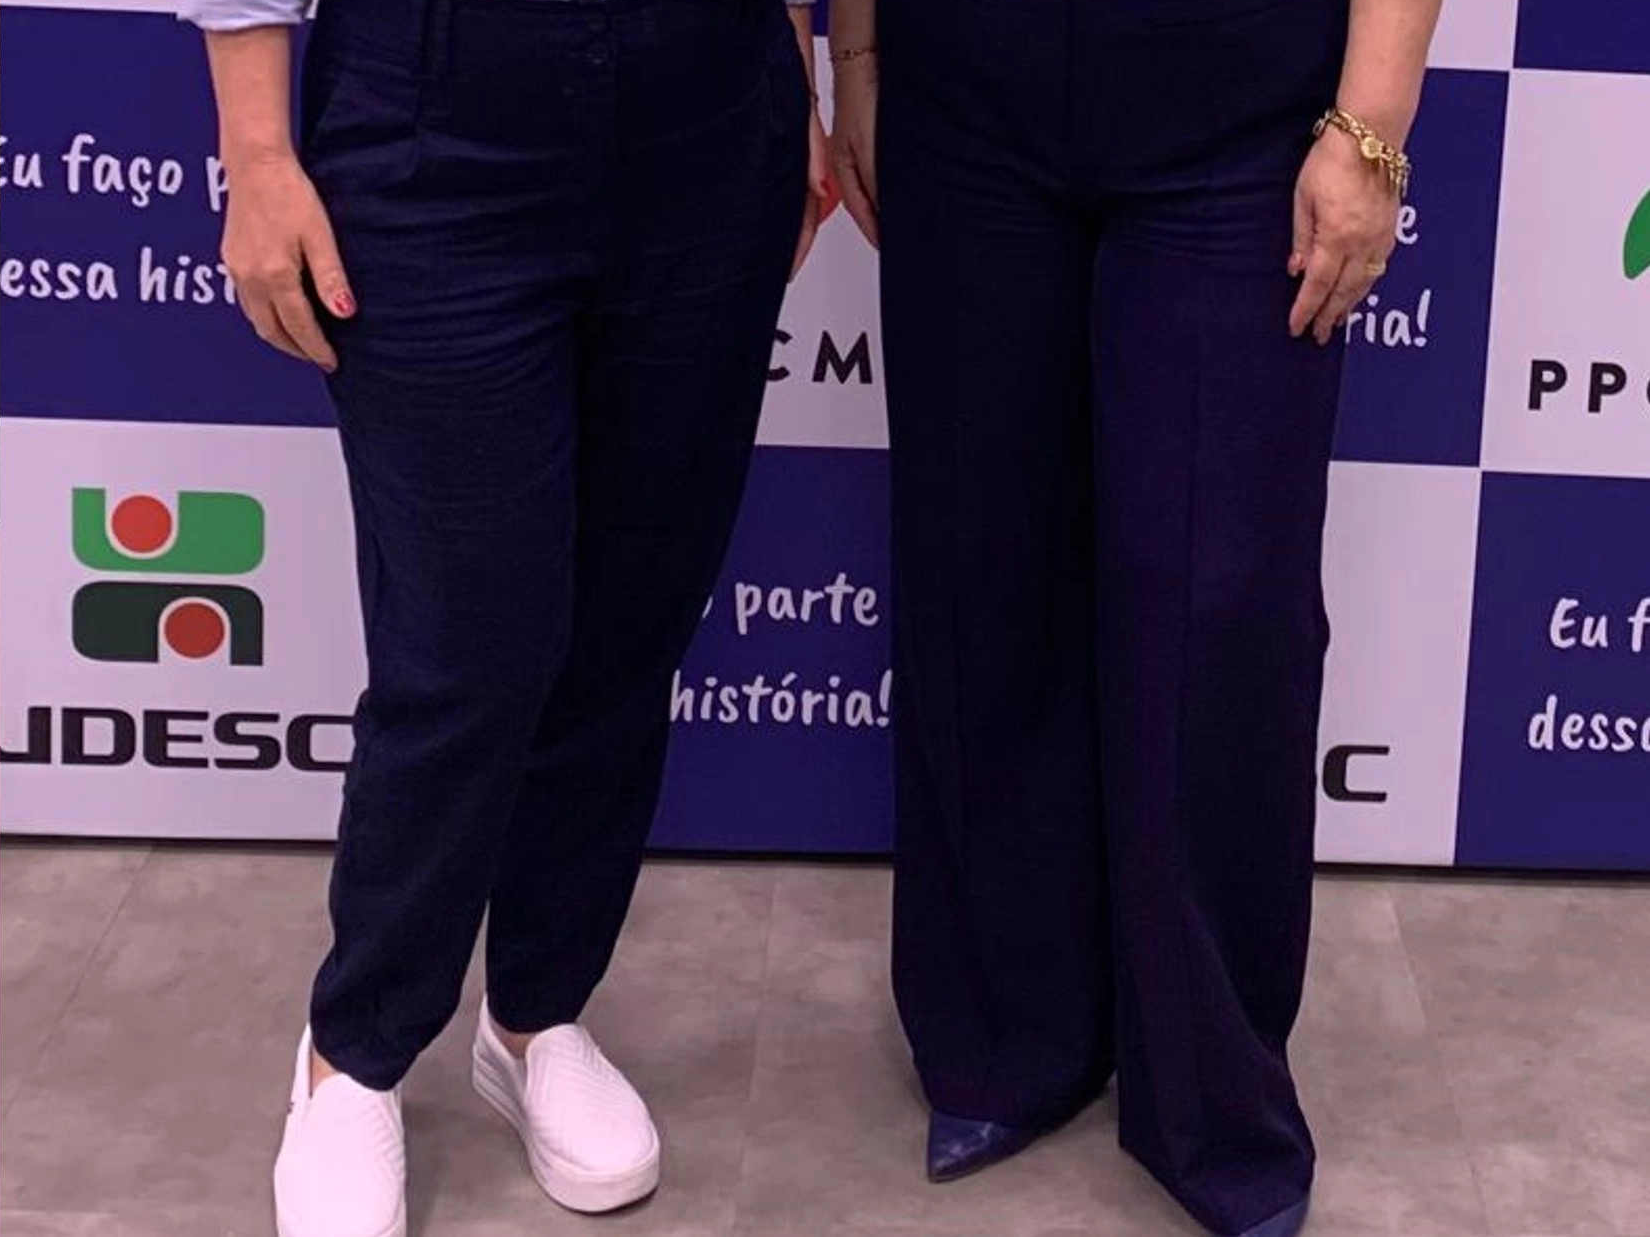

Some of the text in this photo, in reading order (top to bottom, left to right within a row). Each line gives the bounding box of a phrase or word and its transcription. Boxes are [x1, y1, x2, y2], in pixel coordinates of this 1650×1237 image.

[62, 134, 183, 208] faço
[735, 572, 880, 635] parte
[1550, 598, 1608, 648] Eu
[669, 669, 893, 728] história!
